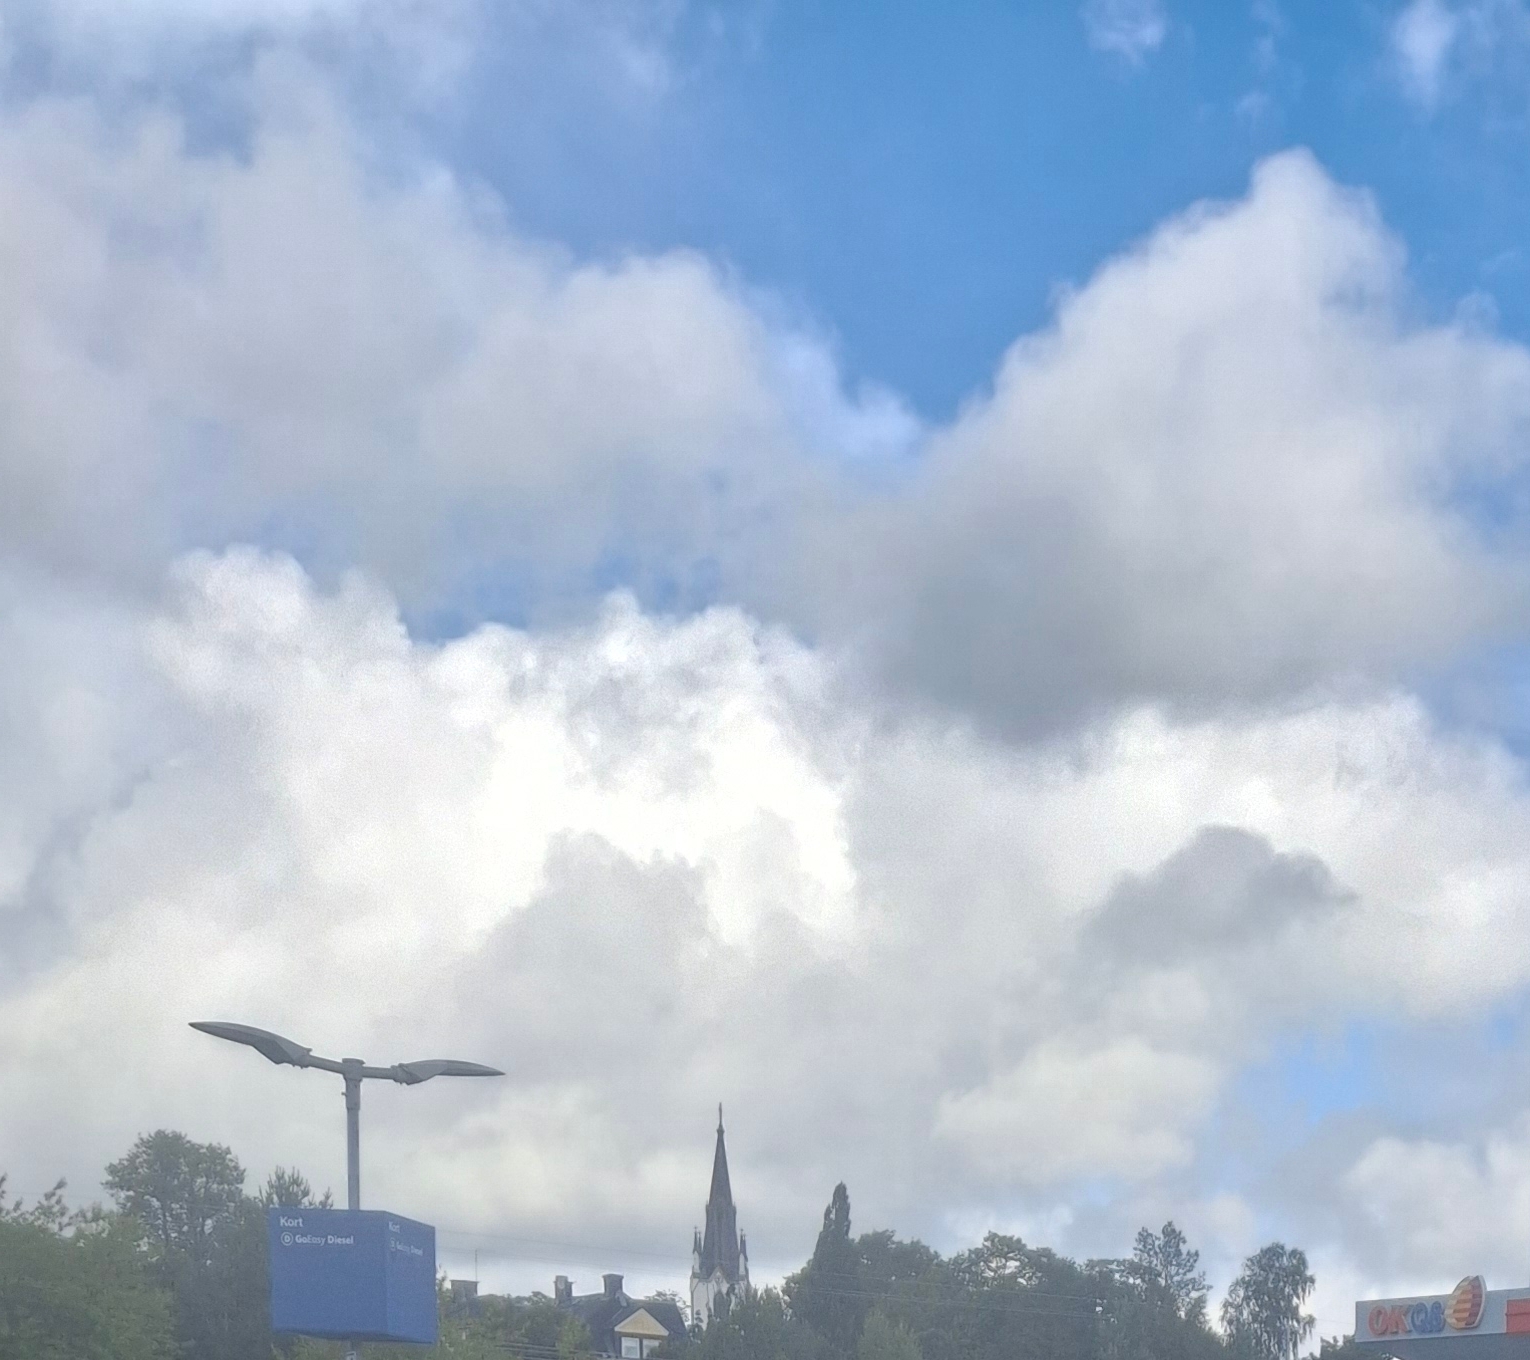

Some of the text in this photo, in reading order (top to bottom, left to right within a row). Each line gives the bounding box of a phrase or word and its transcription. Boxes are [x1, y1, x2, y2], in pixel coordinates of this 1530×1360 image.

[280, 1216, 304, 1227] Kort
[295, 1235, 326, 1247] GoEasy
[327, 1235, 355, 1245] Diesel
